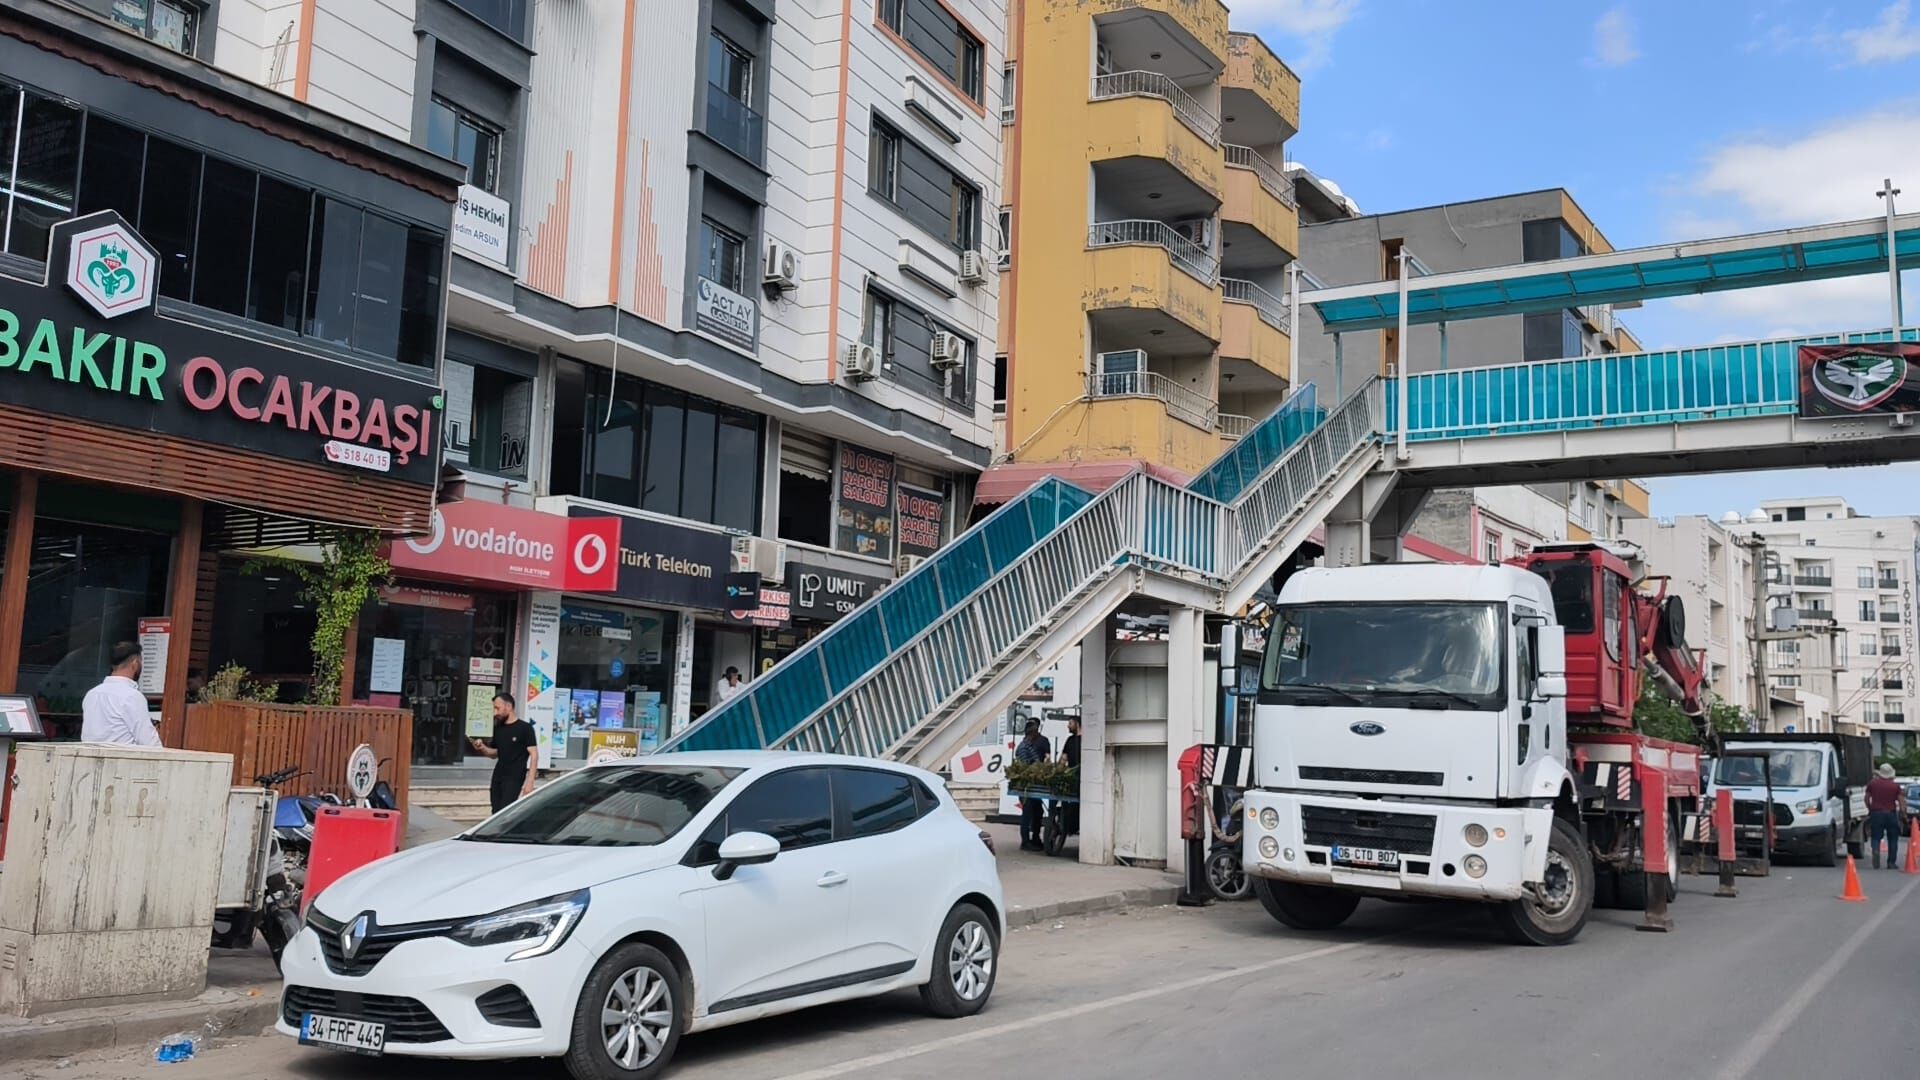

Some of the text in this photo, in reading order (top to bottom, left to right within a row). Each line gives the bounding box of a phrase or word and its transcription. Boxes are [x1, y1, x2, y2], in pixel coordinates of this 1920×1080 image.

[470, 202, 505, 228] HEKİMİ
[473, 229, 500, 248] ARSUN
[712, 292, 751, 320] ACT AY
[0, 308, 430, 465] BAKIR OCAKBAŞI
[344, 448, 387, 467] 518 40 15
[856, 453, 892, 480] OKEY
[842, 470, 888, 495] NARGİLE
[842, 484, 887, 508] SALONU
[910, 496, 943, 521] OKEY
[452, 527, 554, 562] vodafone
[620, 547, 712, 578] Türk Telekom
[827, 576, 866, 598] UMUT
[1339, 847, 1350, 859] 06
[1377, 851, 1396, 862] 807
[309, 1016, 383, 1047] 34 FRF 445
